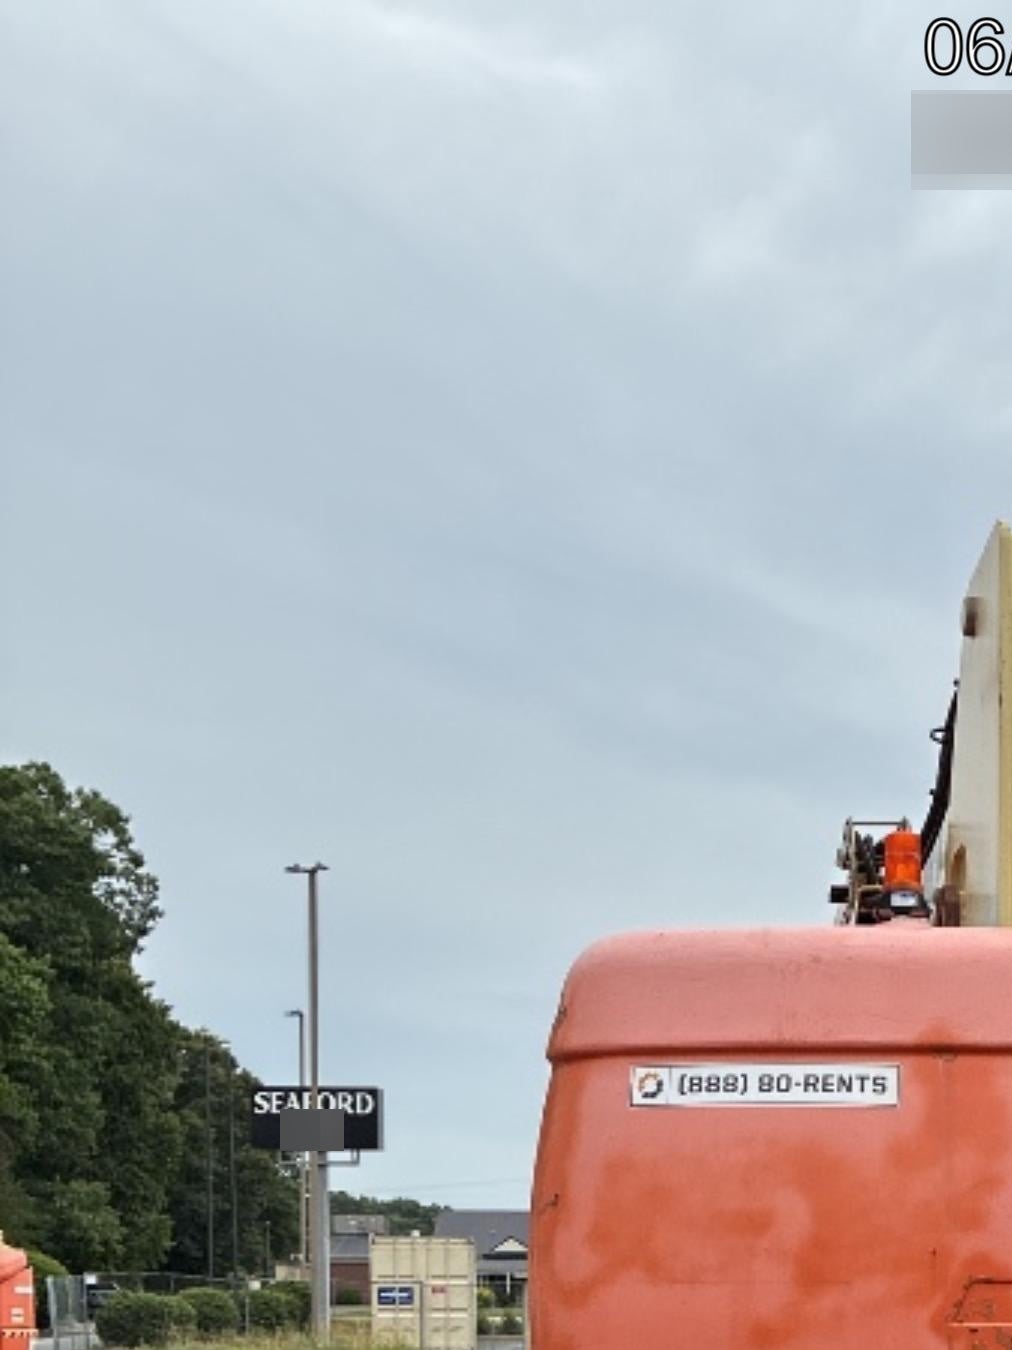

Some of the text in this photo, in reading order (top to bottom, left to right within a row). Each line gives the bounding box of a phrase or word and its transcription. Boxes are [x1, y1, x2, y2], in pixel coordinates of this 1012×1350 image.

[678, 1073, 888, 1096] (888) 80-RENTS
[253, 1091, 375, 1115] SEAFORD
